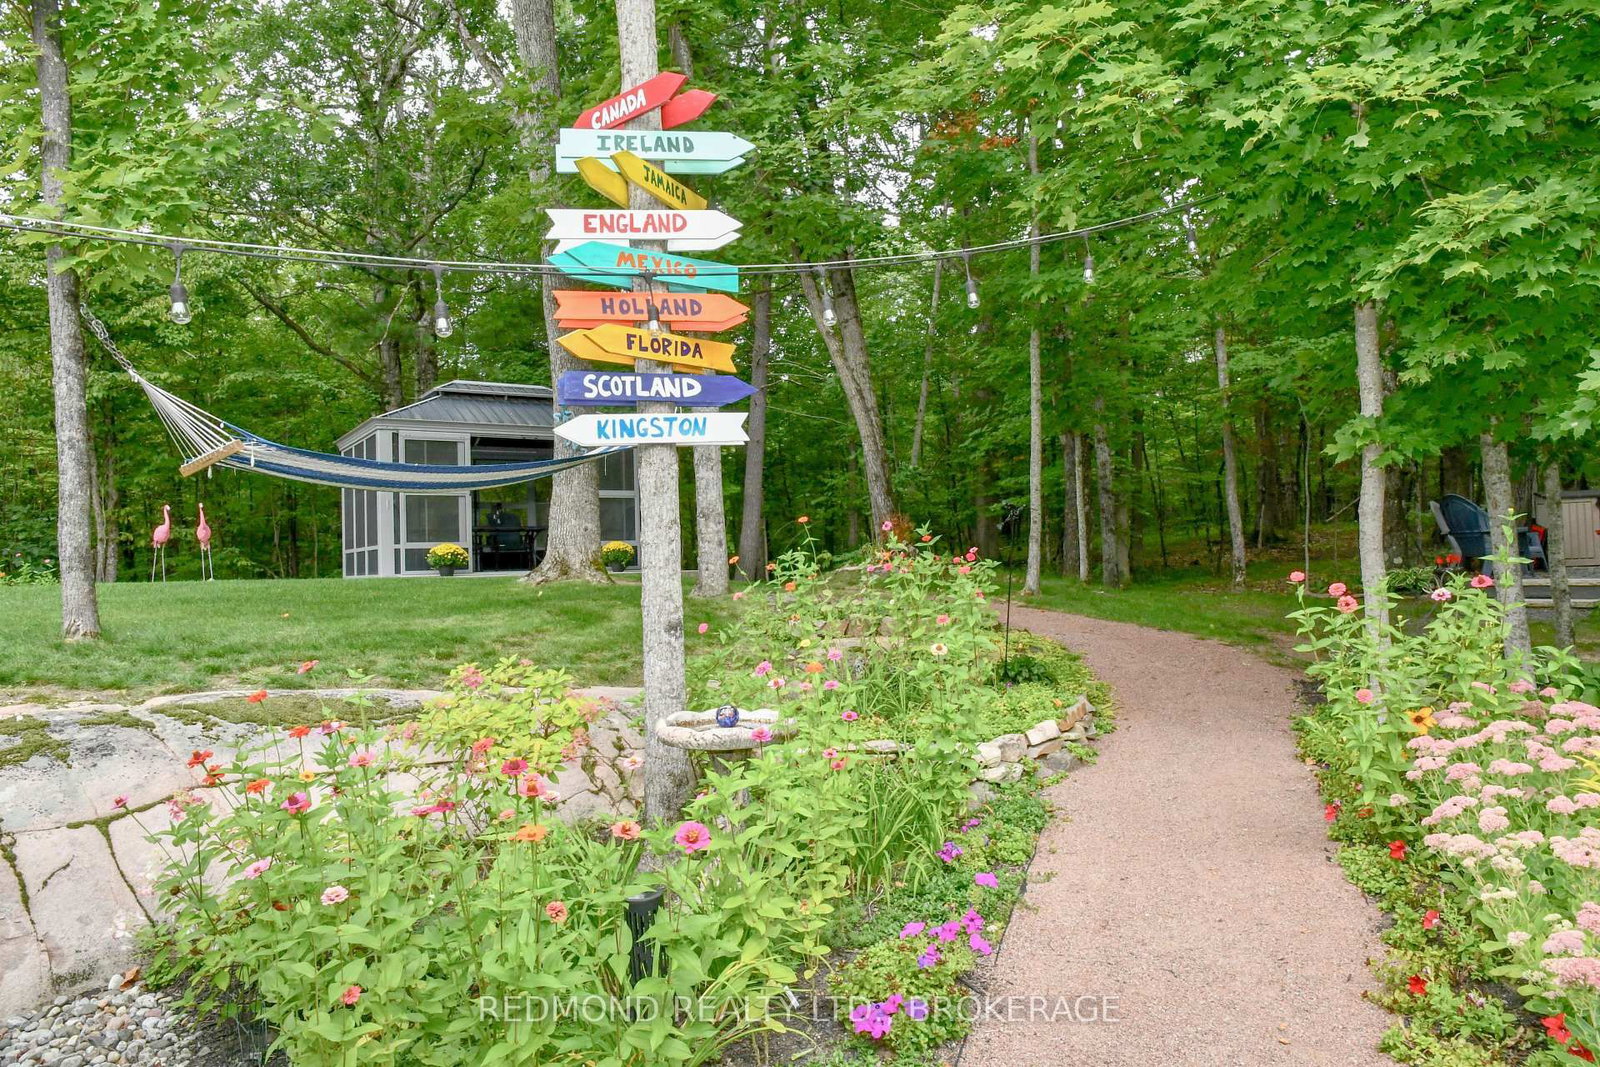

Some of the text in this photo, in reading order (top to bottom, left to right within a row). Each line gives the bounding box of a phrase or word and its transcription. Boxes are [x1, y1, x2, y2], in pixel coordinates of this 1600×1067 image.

[591, 88, 647, 129] CANADA
[597, 134, 694, 153] IRELAND
[642, 164, 687, 206] JAMAICA
[583, 213, 688, 234] ENGLAND
[616, 251, 697, 279] MEXICO
[626, 333, 703, 359] FLORIDA
[583, 373, 702, 398] SCOTLAND
[597, 416, 707, 440] KINGSTON
